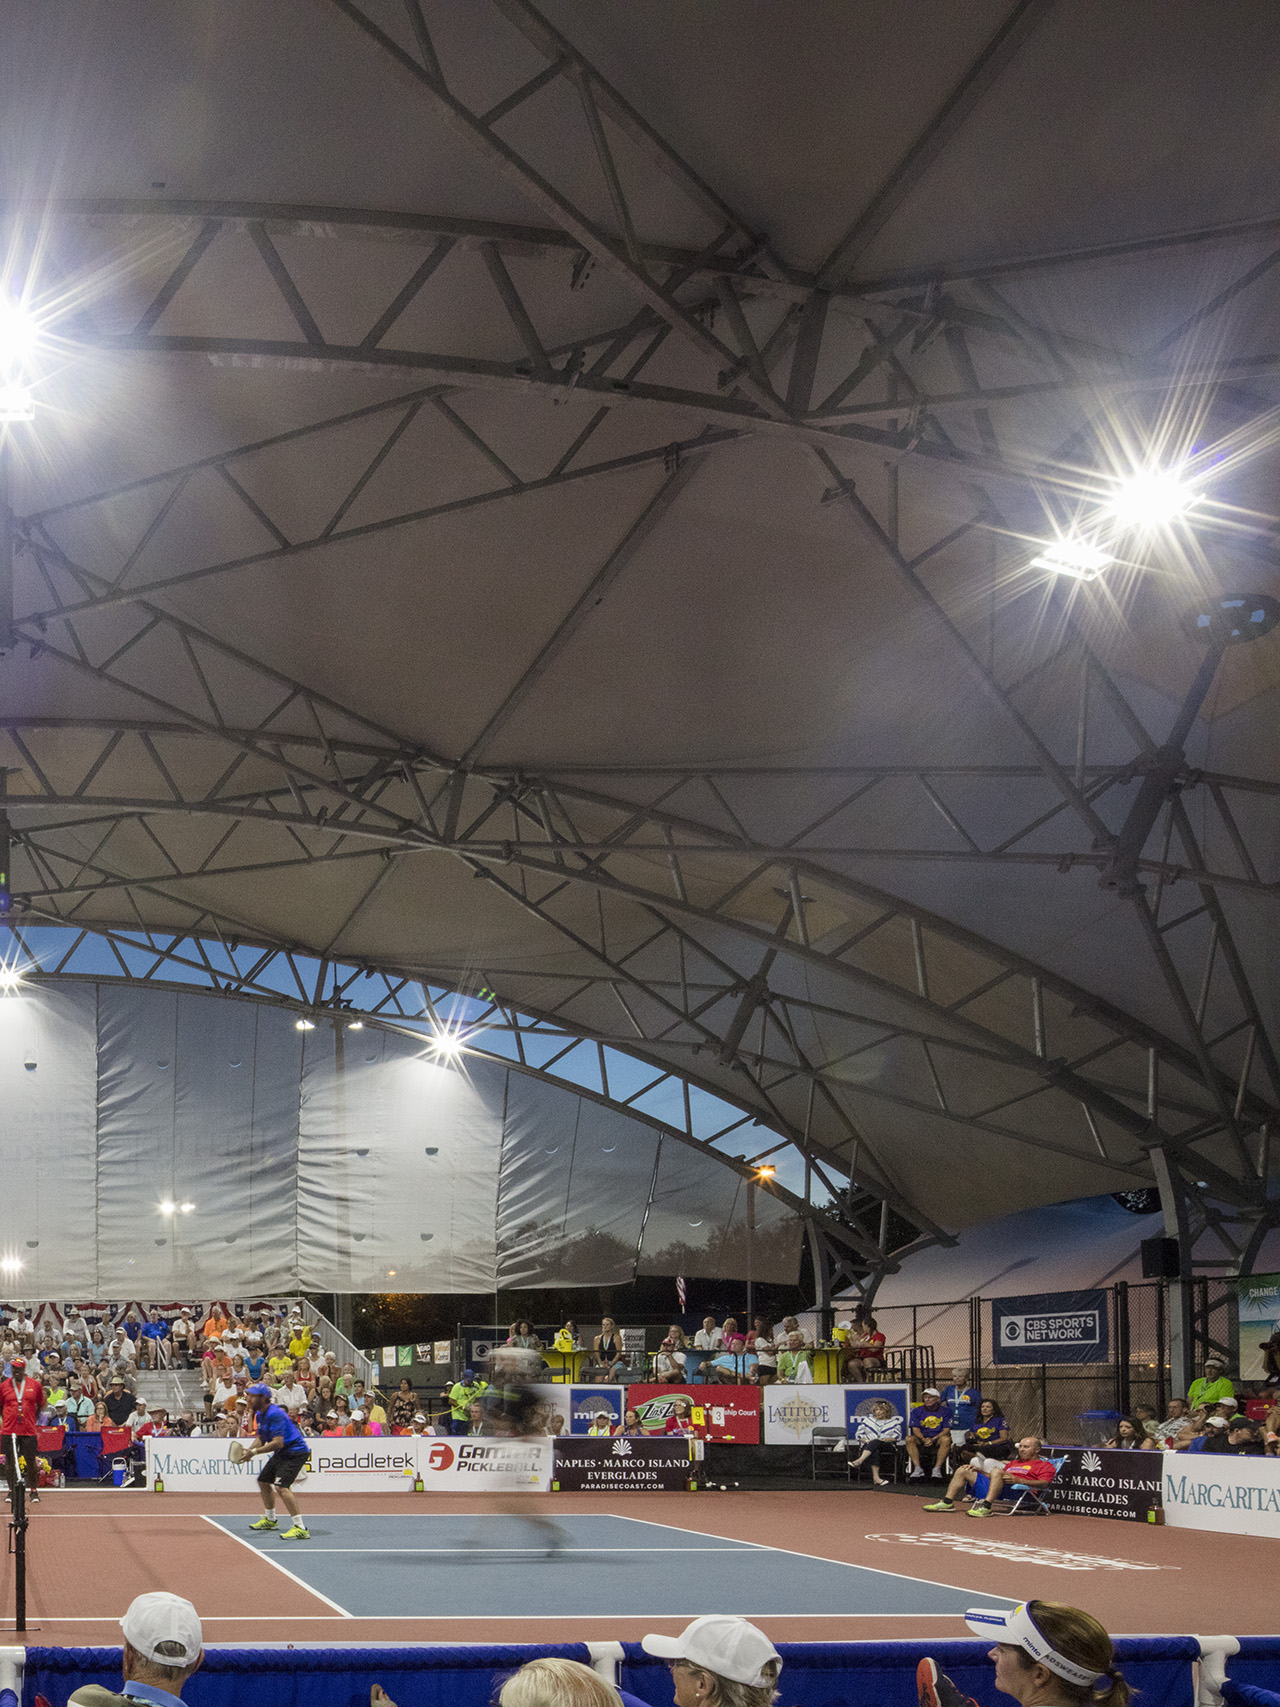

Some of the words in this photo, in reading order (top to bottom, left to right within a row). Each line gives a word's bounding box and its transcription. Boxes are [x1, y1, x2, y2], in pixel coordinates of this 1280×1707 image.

[1026, 1319, 1047, 1331] CBS
[1049, 1316, 1094, 1329] SPORTS
[1026, 1328, 1083, 1340] NETWORK
[695, 1411, 701, 1421] 9
[715, 1411, 722, 1421] 3
[768, 1405, 830, 1423] LATITUDE
[458, 1444, 542, 1459] GAMA
[318, 1452, 414, 1473] paddletek
[555, 1460, 597, 1468] NAPLES
[603, 1459, 646, 1468] MARCO
[648, 1459, 690, 1468] ISLAND
[587, 1471, 658, 1480] EVERGLADES
[1071, 1475, 1115, 1489] MARCO
[1053, 1489, 1129, 1506] EVERGLADES
[1166, 1474, 1280, 1513] MARGARITA
[1046, 1503, 1136, 1518] PARADISECOAST.COM
[1023, 1637, 1041, 1656] minto
